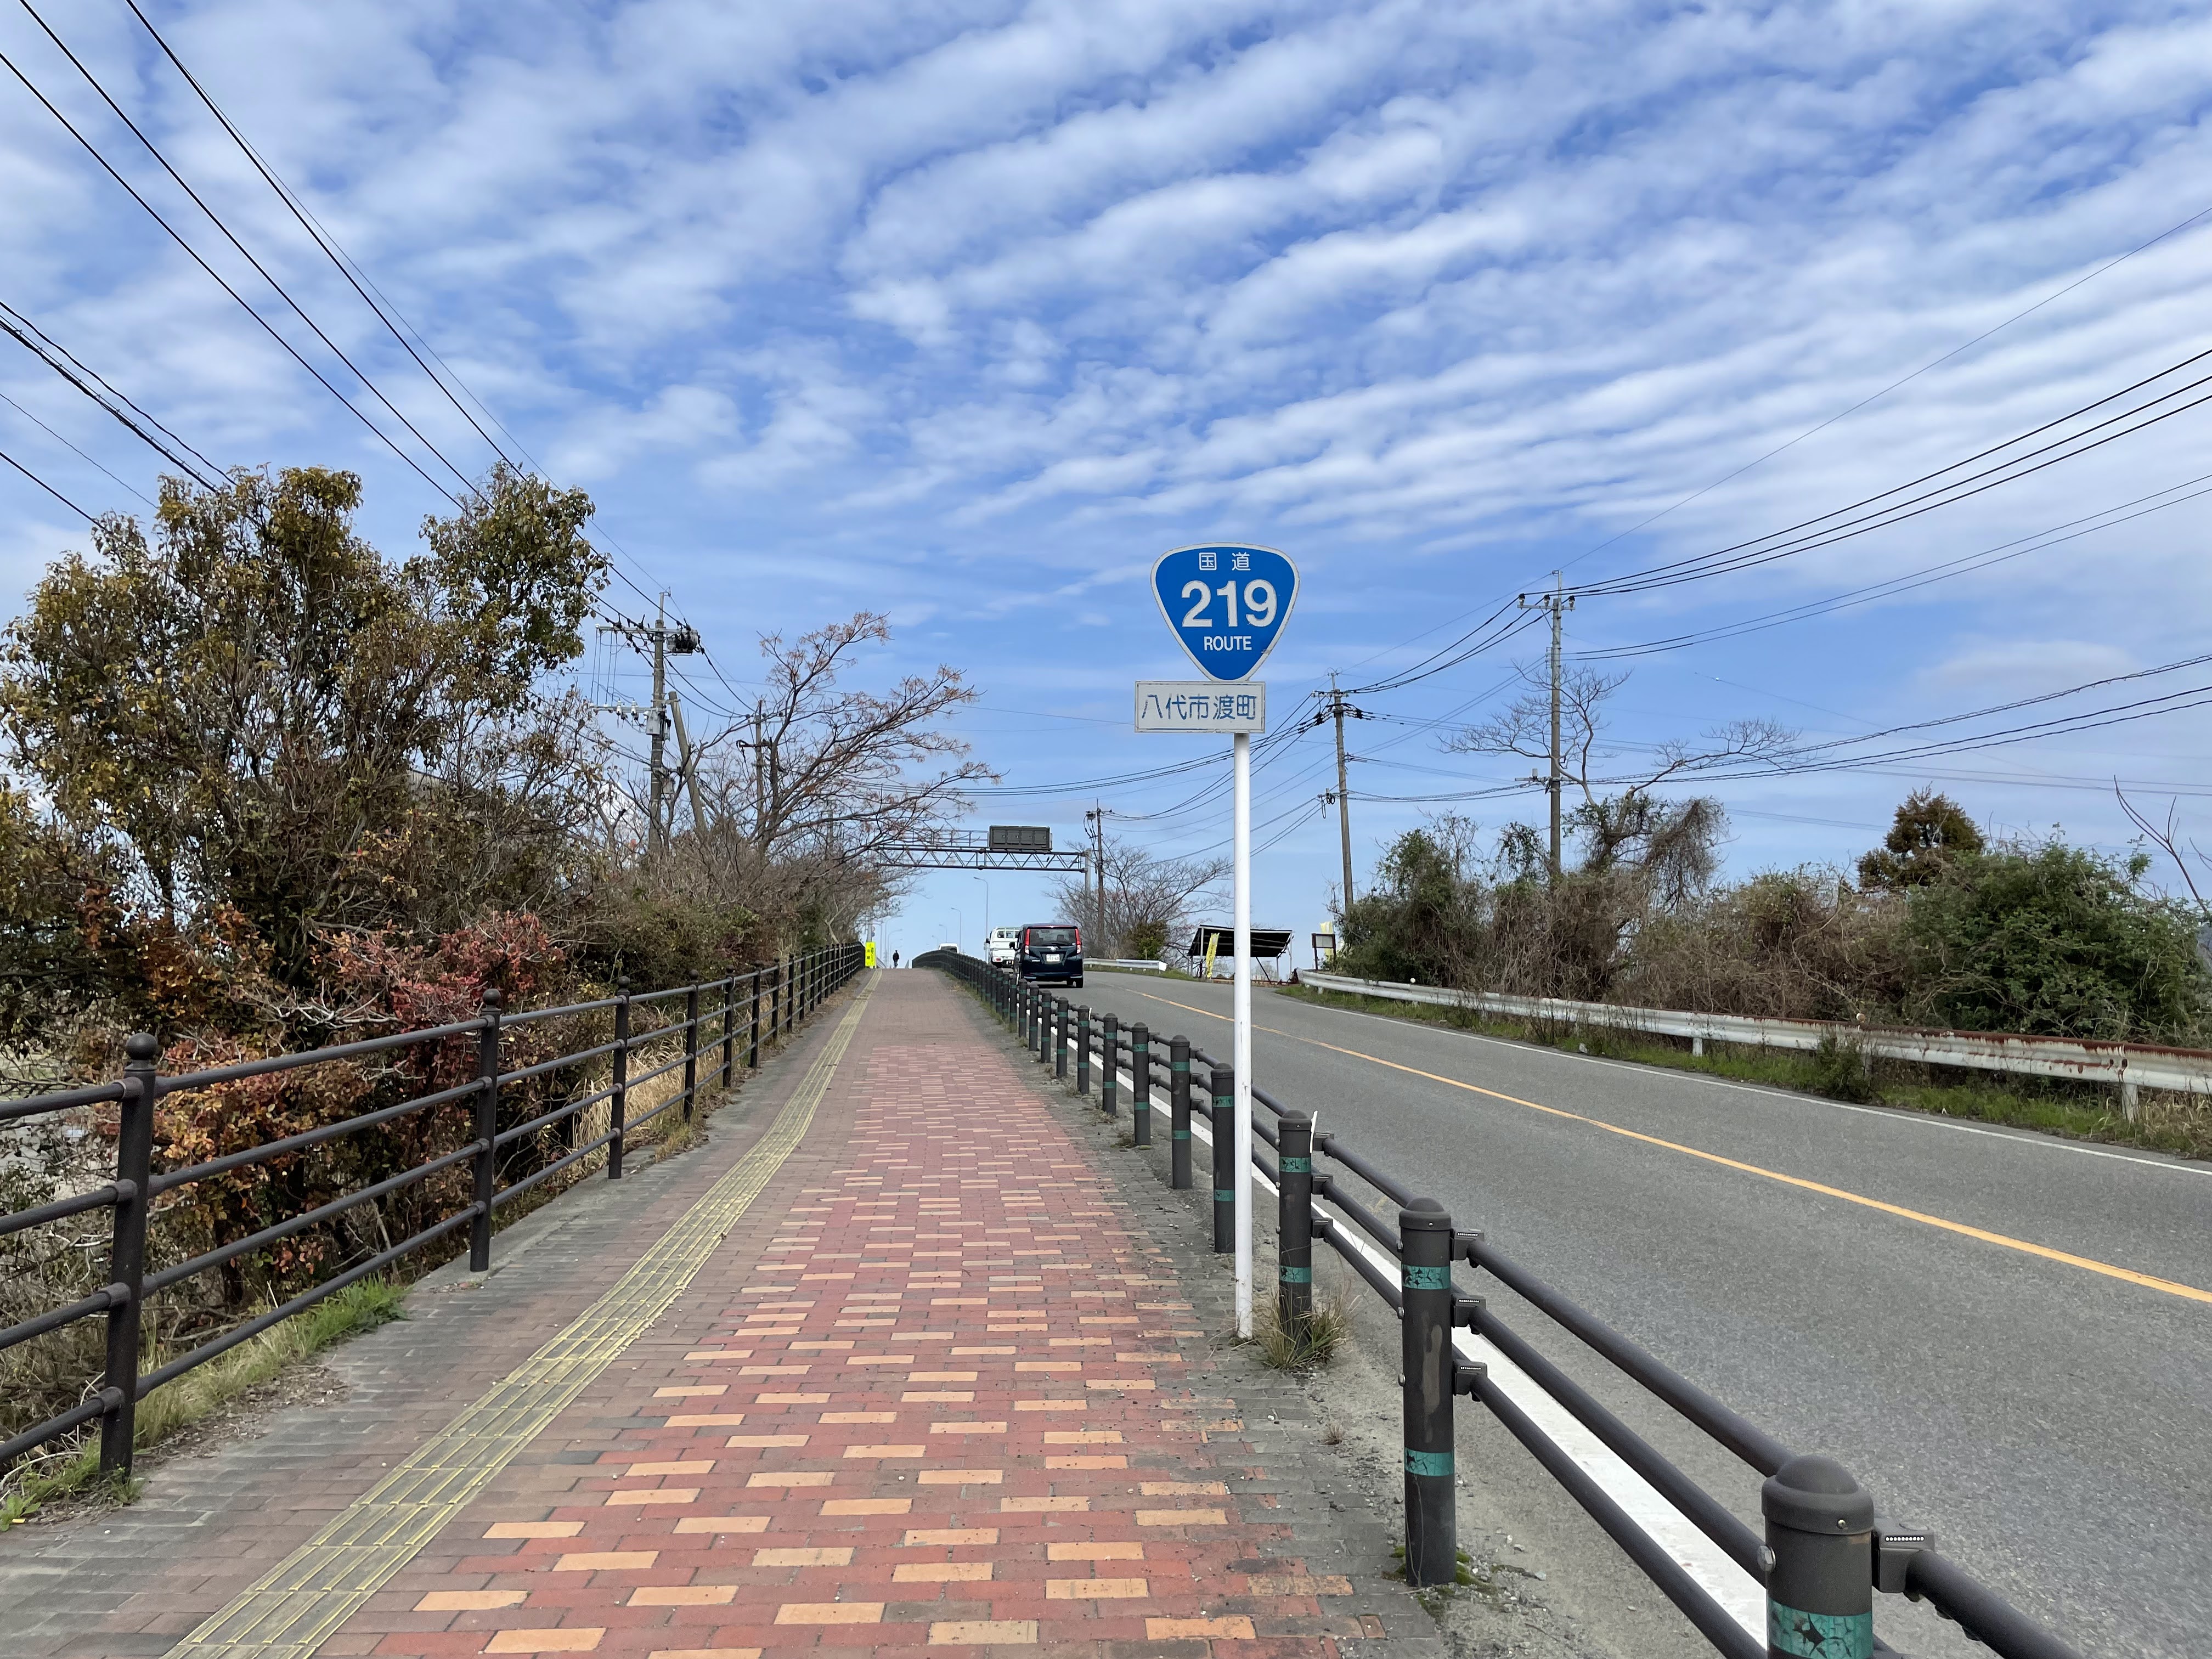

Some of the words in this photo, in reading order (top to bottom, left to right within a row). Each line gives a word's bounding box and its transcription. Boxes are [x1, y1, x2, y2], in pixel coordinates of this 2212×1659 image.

[1199, 552, 1251, 571] 国道
[1181, 579, 1278, 628] 219
[1204, 636, 1252, 651] ROUTE
[1142, 693, 1258, 720] 八代市渡町
